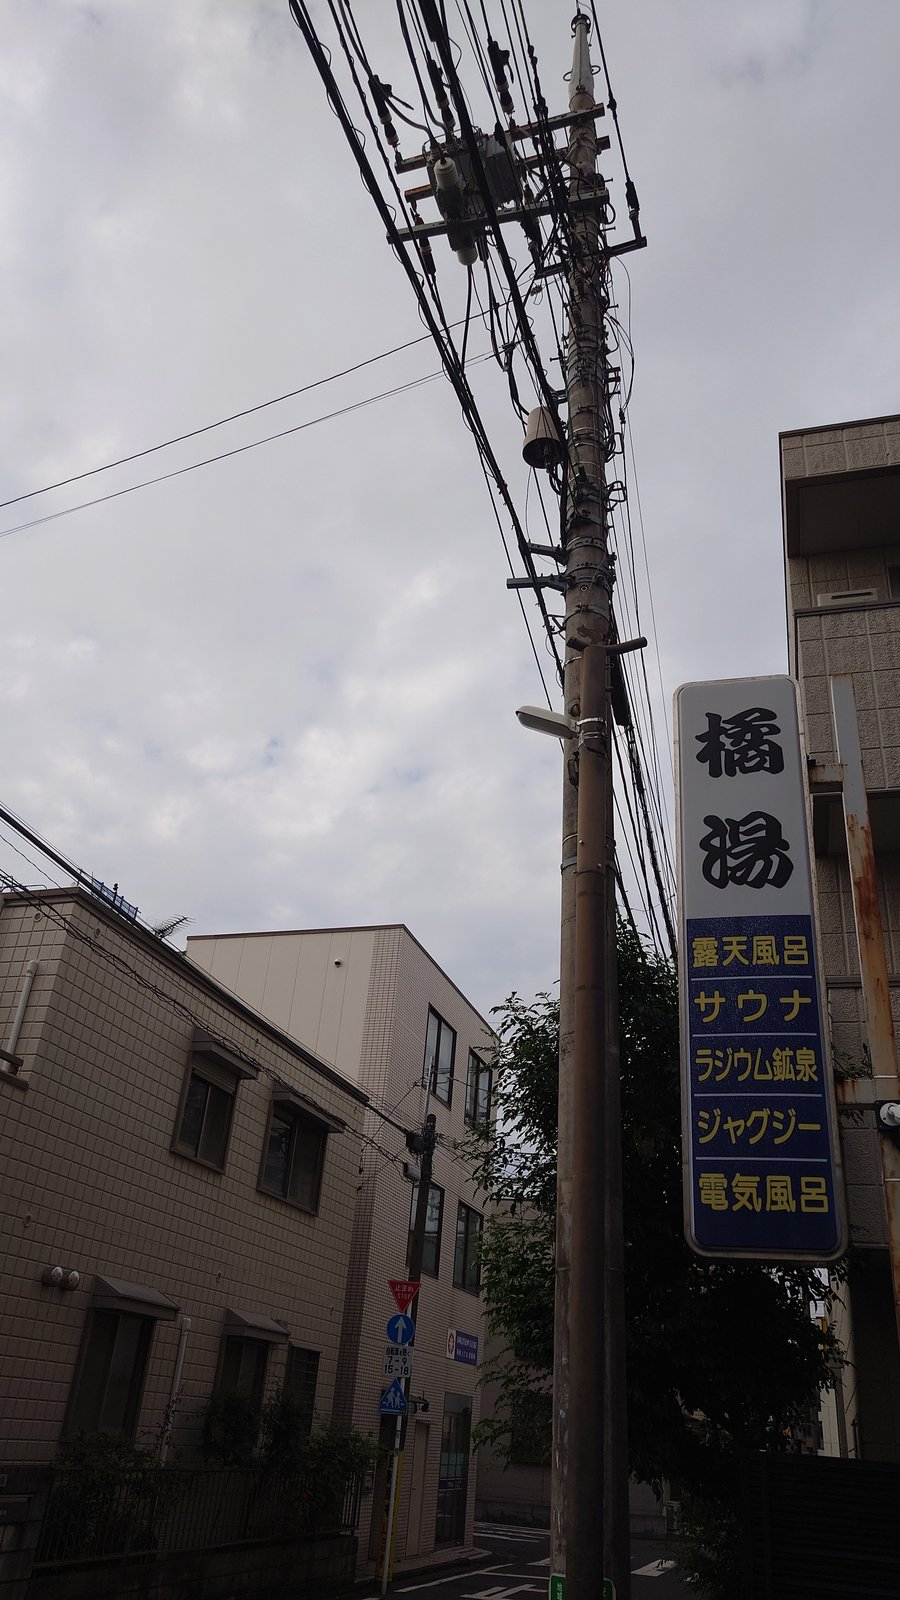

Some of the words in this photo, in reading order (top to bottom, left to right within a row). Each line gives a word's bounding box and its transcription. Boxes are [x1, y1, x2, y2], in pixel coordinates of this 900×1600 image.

[695, 707, 794, 889] 橘湯
[692, 936, 809, 967] 露天風呂
[694, 989, 812, 1022] サウナ
[695, 1047, 818, 1082] ラジウム鉱泉
[698, 1107, 821, 1144] ジャグジー
[699, 1172, 829, 1213] 電気風呂
[394, 1283, 414, 1292] 止まれ
[397, 1292, 411, 1300] STOP
